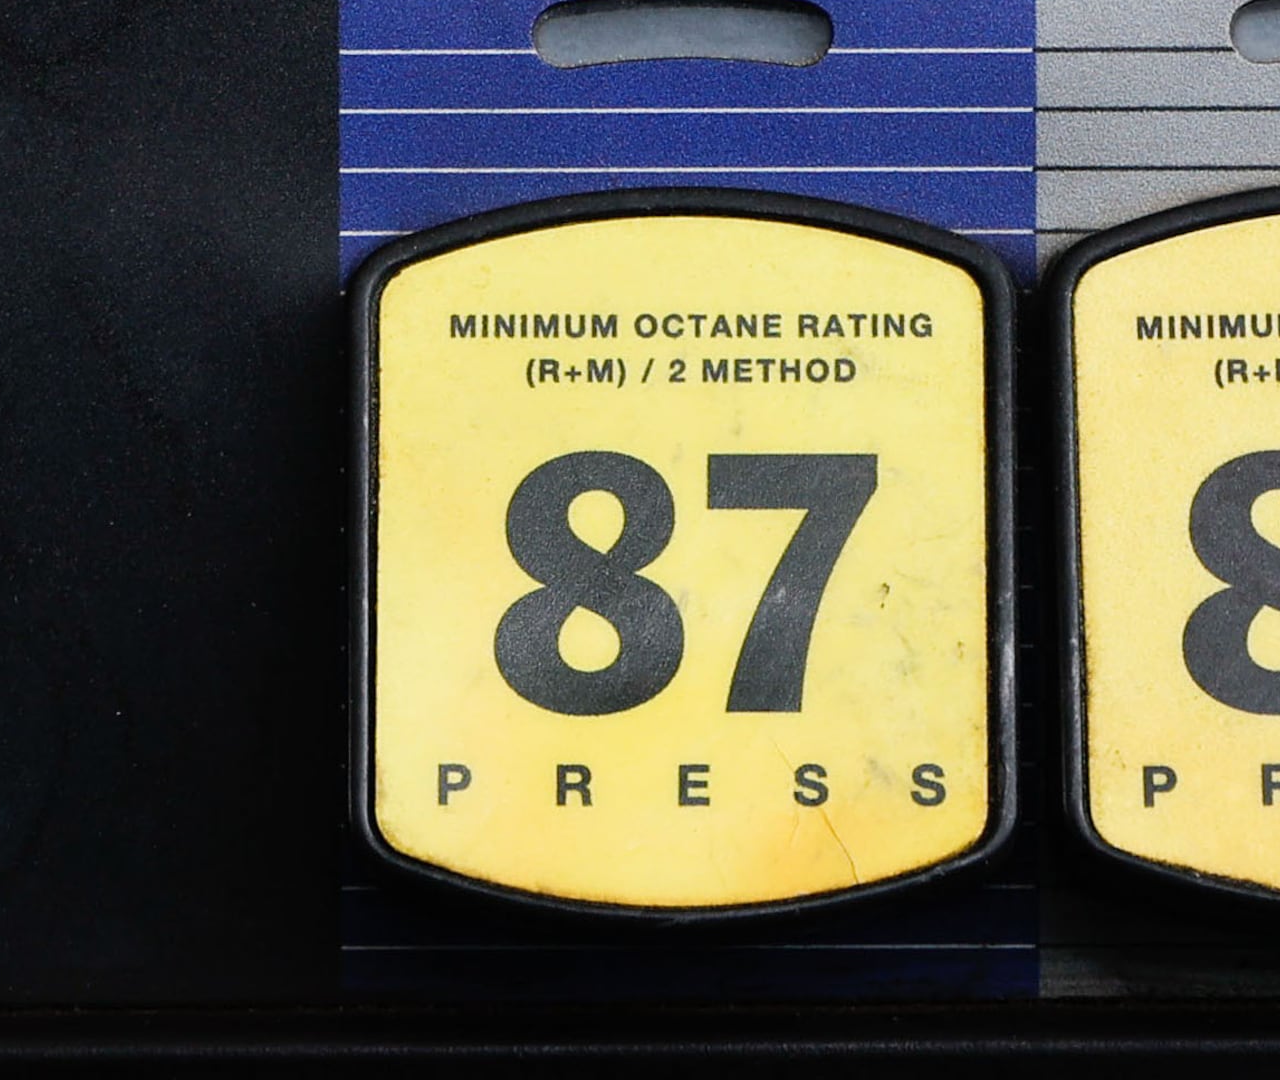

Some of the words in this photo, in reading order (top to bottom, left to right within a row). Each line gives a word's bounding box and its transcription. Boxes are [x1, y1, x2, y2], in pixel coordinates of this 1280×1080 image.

[449, 313, 619, 339] MINIMUM
[633, 313, 782, 338] OCTANE
[798, 312, 933, 338] RATING
[526, 358, 626, 386] (R+M)
[642, 359, 654, 384] /
[668, 359, 687, 383] 2
[702, 358, 857, 383] METHOD
[494, 450, 879, 716] 87
